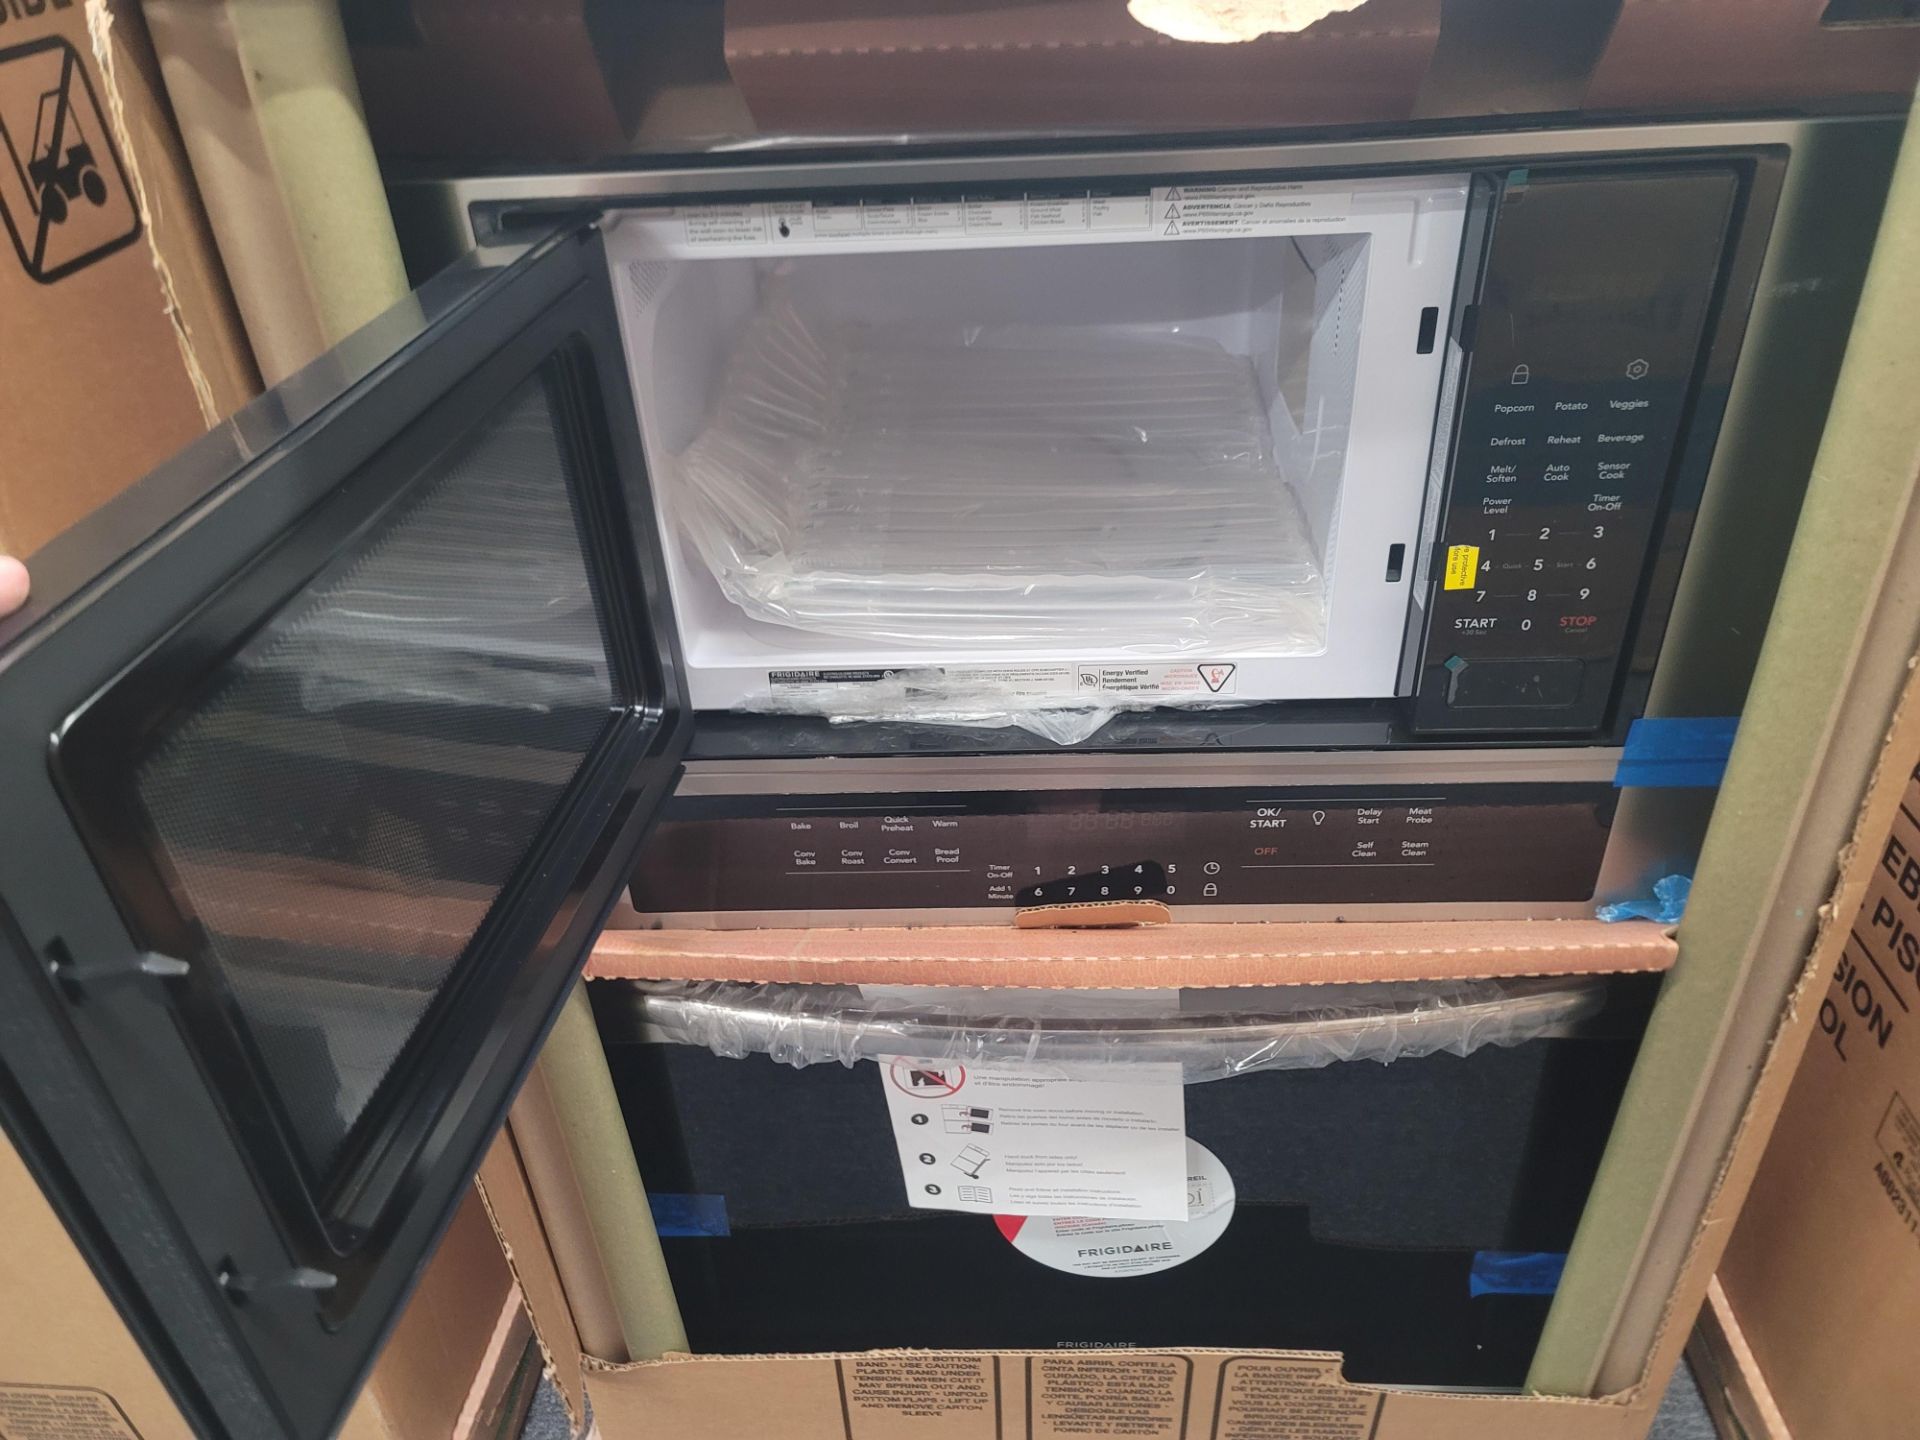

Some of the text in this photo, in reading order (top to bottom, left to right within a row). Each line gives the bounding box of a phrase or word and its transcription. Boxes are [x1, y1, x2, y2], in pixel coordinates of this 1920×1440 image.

[1495, 400, 1649, 414] Popcorn Potato Veggies
[1490, 433, 1644, 447] Defrost Reheat Beverage
[1490, 464, 1516, 474] Melt/
[1546, 464, 1570, 473] Auto
[1598, 461, 1630, 471] Sensor
[1486, 474, 1517, 484] Soften
[1544, 473, 1569, 482] Cook
[1599, 470, 1625, 480] Cook
[1483, 497, 1512, 506] Power
[1592, 494, 1621, 503] Timer
[1484, 506, 1508, 515] Level
[1588, 502, 1622, 512] On-Off
[1488, 526, 1605, 541] 1 2 3
[1480, 560, 1491, 572] 4
[1533, 558, 1544, 572] 5
[1586, 558, 1597, 570] 6
[1476, 588, 1591, 603] 7 8 9
[1454, 616, 1597, 631] START 0 STOP
[771, 670, 820, 678] FRIGIDAIRE
[1125, 668, 1149, 676] Verified
[1257, 808, 1282, 817] OK/
[1357, 808, 1383, 817] Delay
[1408, 807, 1433, 816] Meat
[884, 816, 910, 825] Quick
[932, 820, 959, 828] Warm
[1250, 820, 1287, 829] START
[1358, 816, 1380, 825] Start
[1406, 816, 1433, 824] Probe
[791, 821, 859, 831] Bake Broil
[881, 824, 914, 832] Preheat
[1357, 841, 1375, 850] Self
[1401, 840, 1430, 849] Steam
[794, 850, 816, 859] Conv
[842, 850, 864, 858] Conv
[889, 848, 911, 857] Conv
[934, 848, 960, 856] Bread
[1254, 847, 1279, 856] OFF
[1352, 850, 1377, 858] Clean
[1401, 848, 1427, 857] Clean
[796, 858, 817, 866] Bake
[842, 857, 865, 865] Roast
[884, 856, 917, 865] Convert
[936, 855, 960, 864] Proof
[1034, 864, 1176, 876] 1 2 3 4 5
[1882, 835, 1920, 906] EB
[987, 871, 1013, 879] On-Off
[988, 885, 1006, 893] Add
[1034, 886, 1176, 897] 6 7 8 9 0
[1078, 1241, 1174, 1258] FRIGIDAIRE
[1057, 1341, 1137, 1349] FRIGIDAIRE
[1044, 1358, 1074, 1366] PARA
[1118, 1360, 1157, 1368] CORTE
[1078, 1366, 1131, 1374] INFERIOR
[1238, 1365, 1272, 1373] POUR
[1044, 1372, 1101, 1380] CUIDADO,
[1120, 1374, 1155, 1382] CINTA
[852, 1388, 890, 1396] CAUSE
